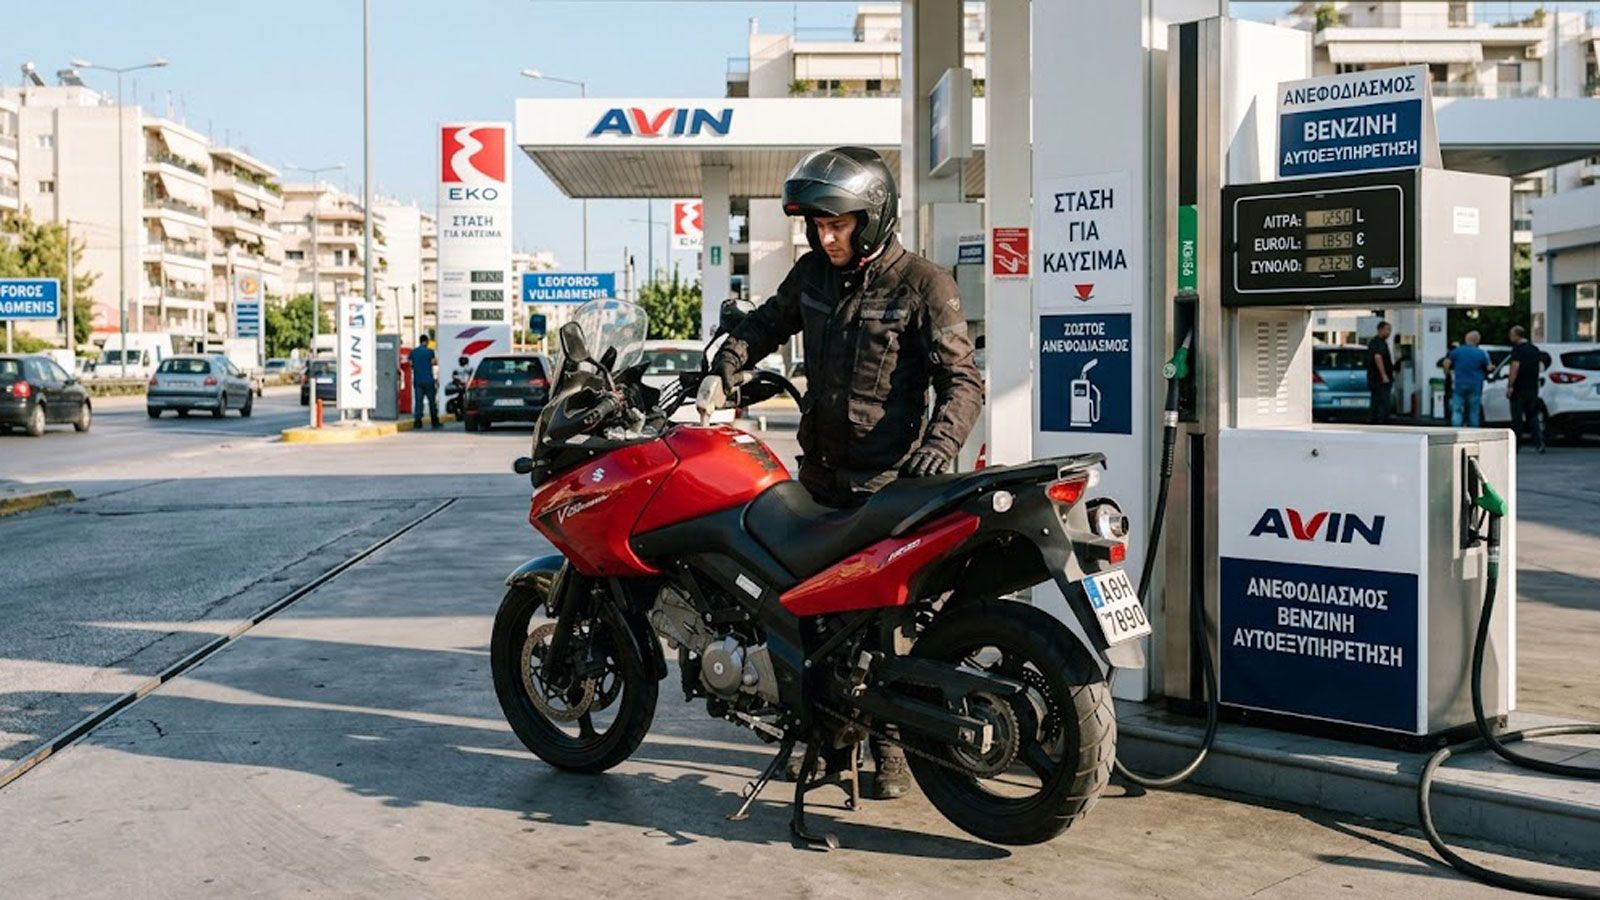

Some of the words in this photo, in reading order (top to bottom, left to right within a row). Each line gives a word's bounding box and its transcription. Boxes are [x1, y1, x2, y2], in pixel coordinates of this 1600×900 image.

[1283, 75, 1416, 106] ΑΝΕΦΟΔΙΑΣΜΟΣ
[588, 106, 734, 136] AVIN
[1303, 113, 1397, 142] ΒΕΝΖΙΝΗ
[1283, 140, 1418, 165] ΑΥΤΟΕΞΥΠΗΡΕΤΗΣΗ
[448, 187, 498, 201] EKO
[1054, 188, 1113, 213] ΣΤΑΣΗ
[1356, 209, 1365, 223] L
[1069, 220, 1099, 242] ΓΙΑ
[1254, 236, 1302, 252] EURO/L:
[1043, 249, 1127, 273] ΚΑΥΣΙΜΑ
[350, 335, 363, 394] AVIN
[1248, 508, 1386, 545] AVIN
[1246, 577, 1388, 610] ΑΝΕΦΟΔΙΑΣΜΟΣ
[1277, 606, 1355, 633] ΒΕΝΖΙΝΗ
[1232, 627, 1403, 667] ΑΥΤΟΕΞΥΠΗΡΕΤΗΣΗ
